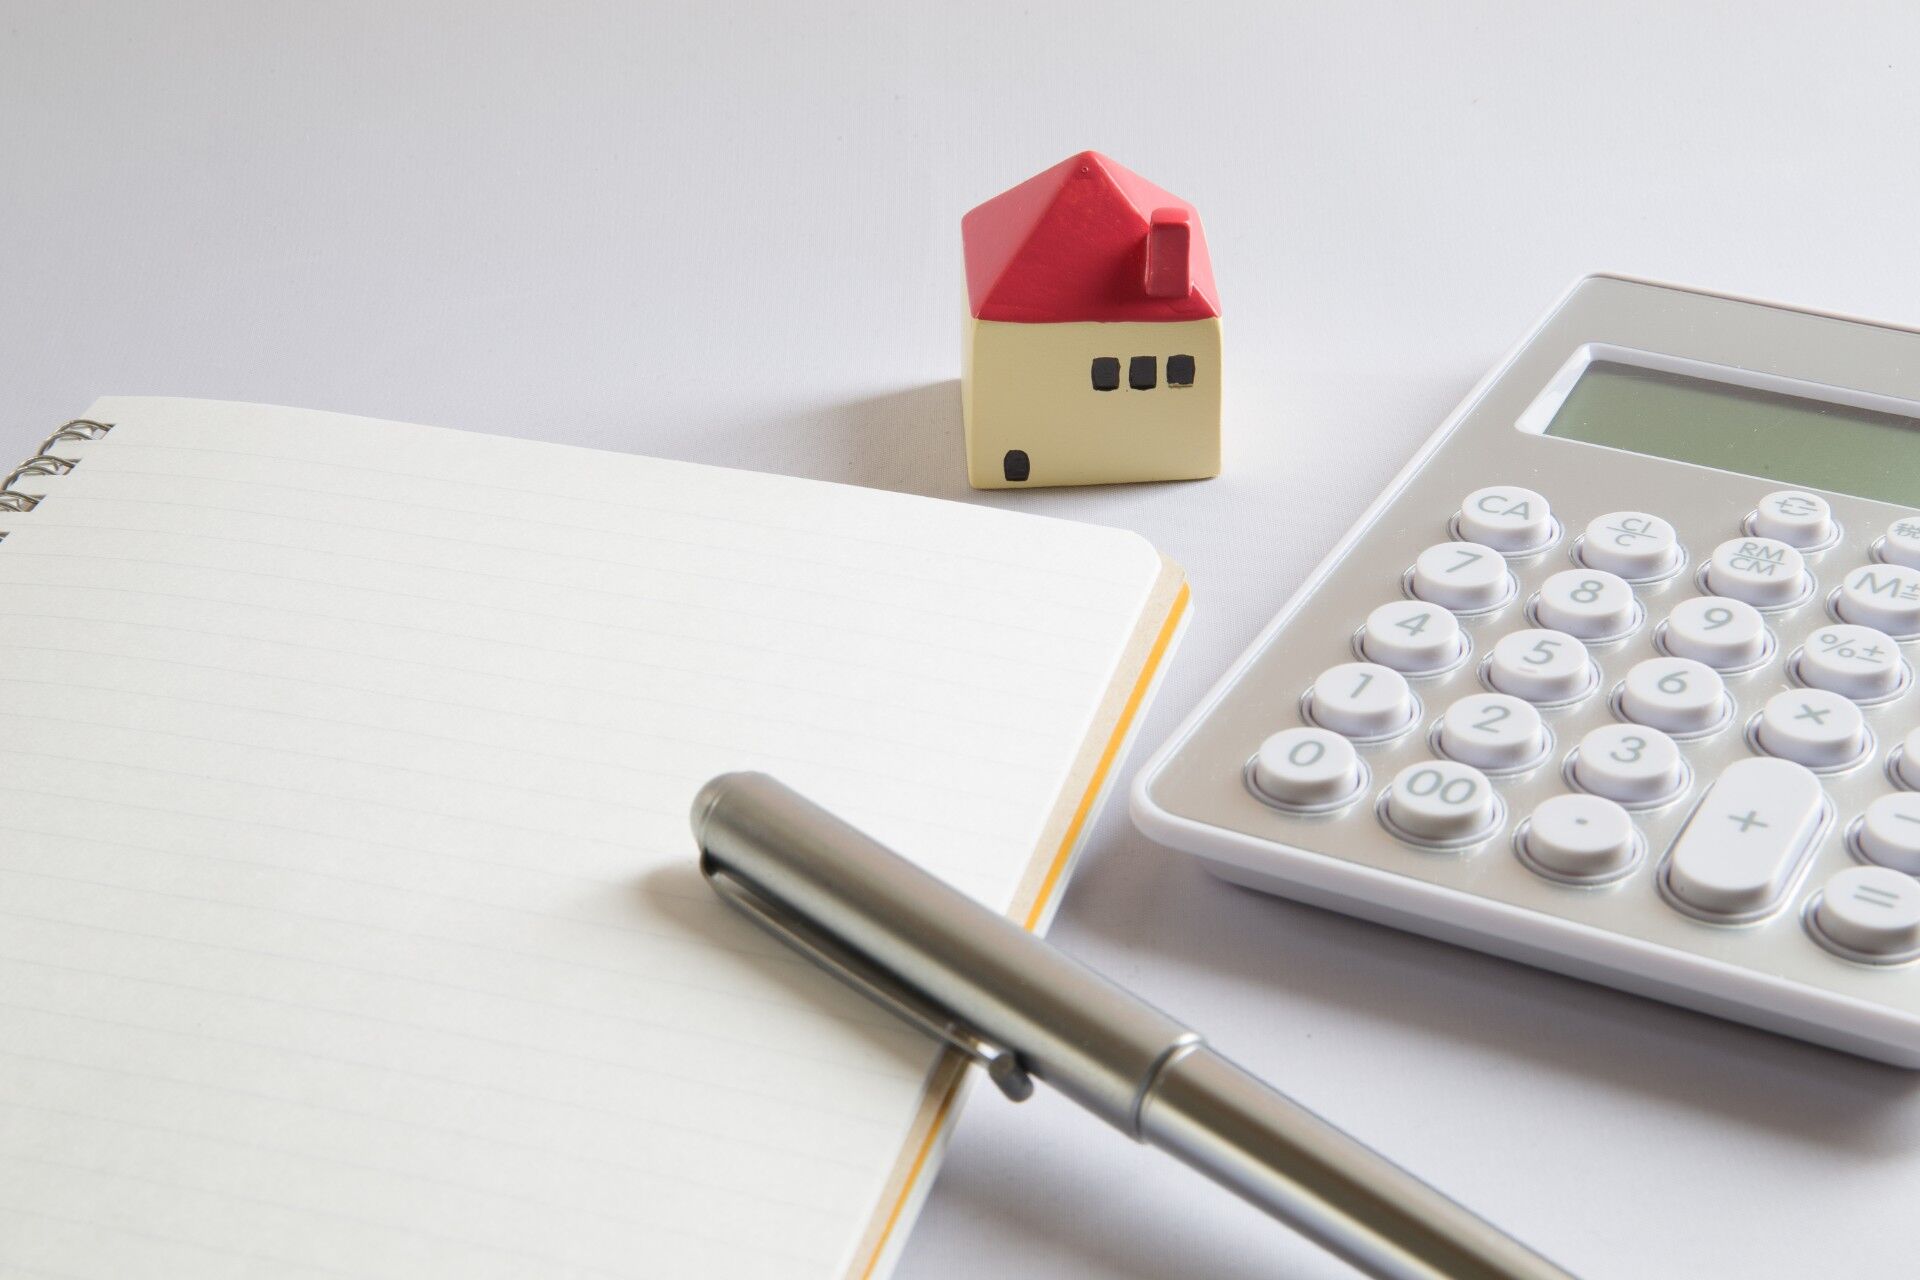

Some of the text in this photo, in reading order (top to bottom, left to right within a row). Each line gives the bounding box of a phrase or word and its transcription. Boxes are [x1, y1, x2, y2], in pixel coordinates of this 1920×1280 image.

[1477, 495, 1530, 520] CA
[1615, 533, 1636, 547] C
[1738, 542, 1785, 561] RM
[1446, 550, 1483, 573] 7
[1729, 556, 1775, 576] CM
[1570, 579, 1604, 603] 8
[1395, 612, 1431, 636] 4
[1703, 607, 1734, 630] 9
[1522, 639, 1562, 665] 5
[1349, 673, 1374, 699] 1
[1657, 670, 1690, 695] 6
[1471, 705, 1511, 734] 2
[1288, 740, 1326, 767] 0
[1609, 736, 1646, 764] 3
[1406, 769, 1477, 805] 00
